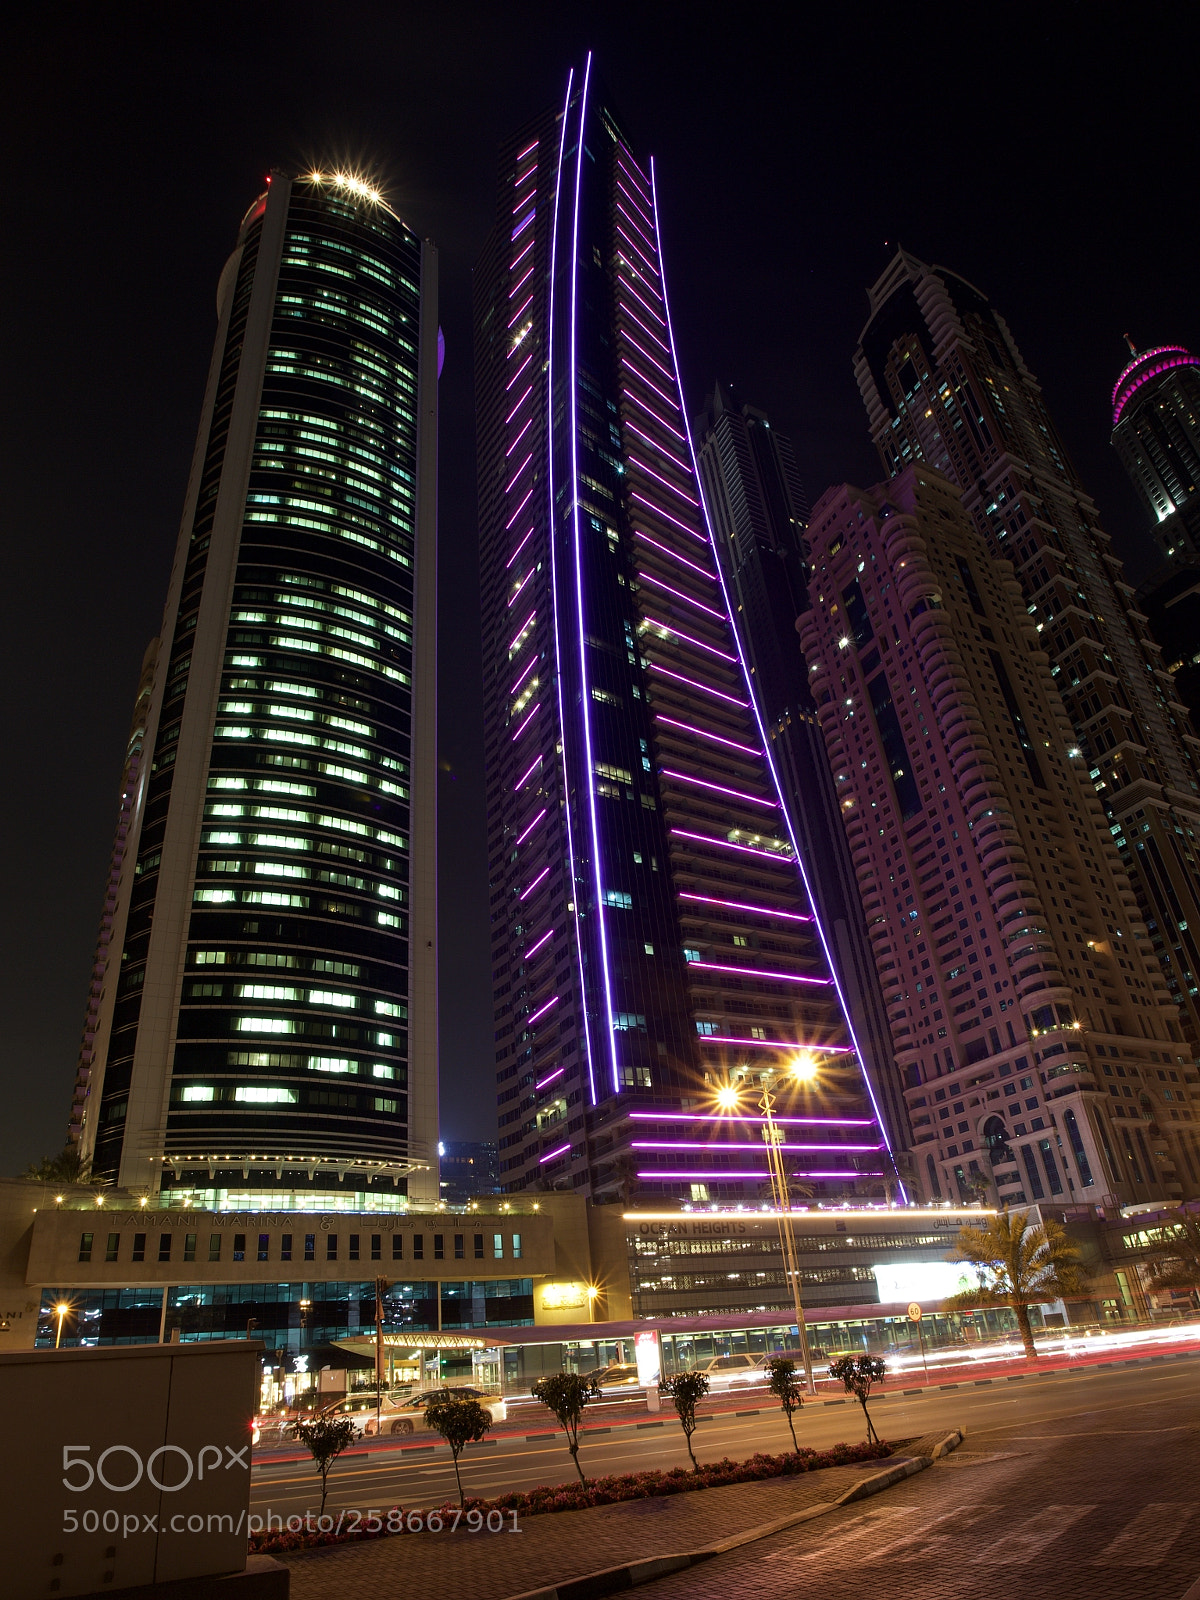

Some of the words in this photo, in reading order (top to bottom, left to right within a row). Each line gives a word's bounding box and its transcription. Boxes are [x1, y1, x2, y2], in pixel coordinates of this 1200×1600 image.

[110, 1214, 198, 1226] TAMANI
[212, 1215, 294, 1227] MARINA
[640, 1222, 688, 1235] OCEAN
[692, 1221, 746, 1234] HEIGHTS
[910, 1307, 919, 1316] 60
